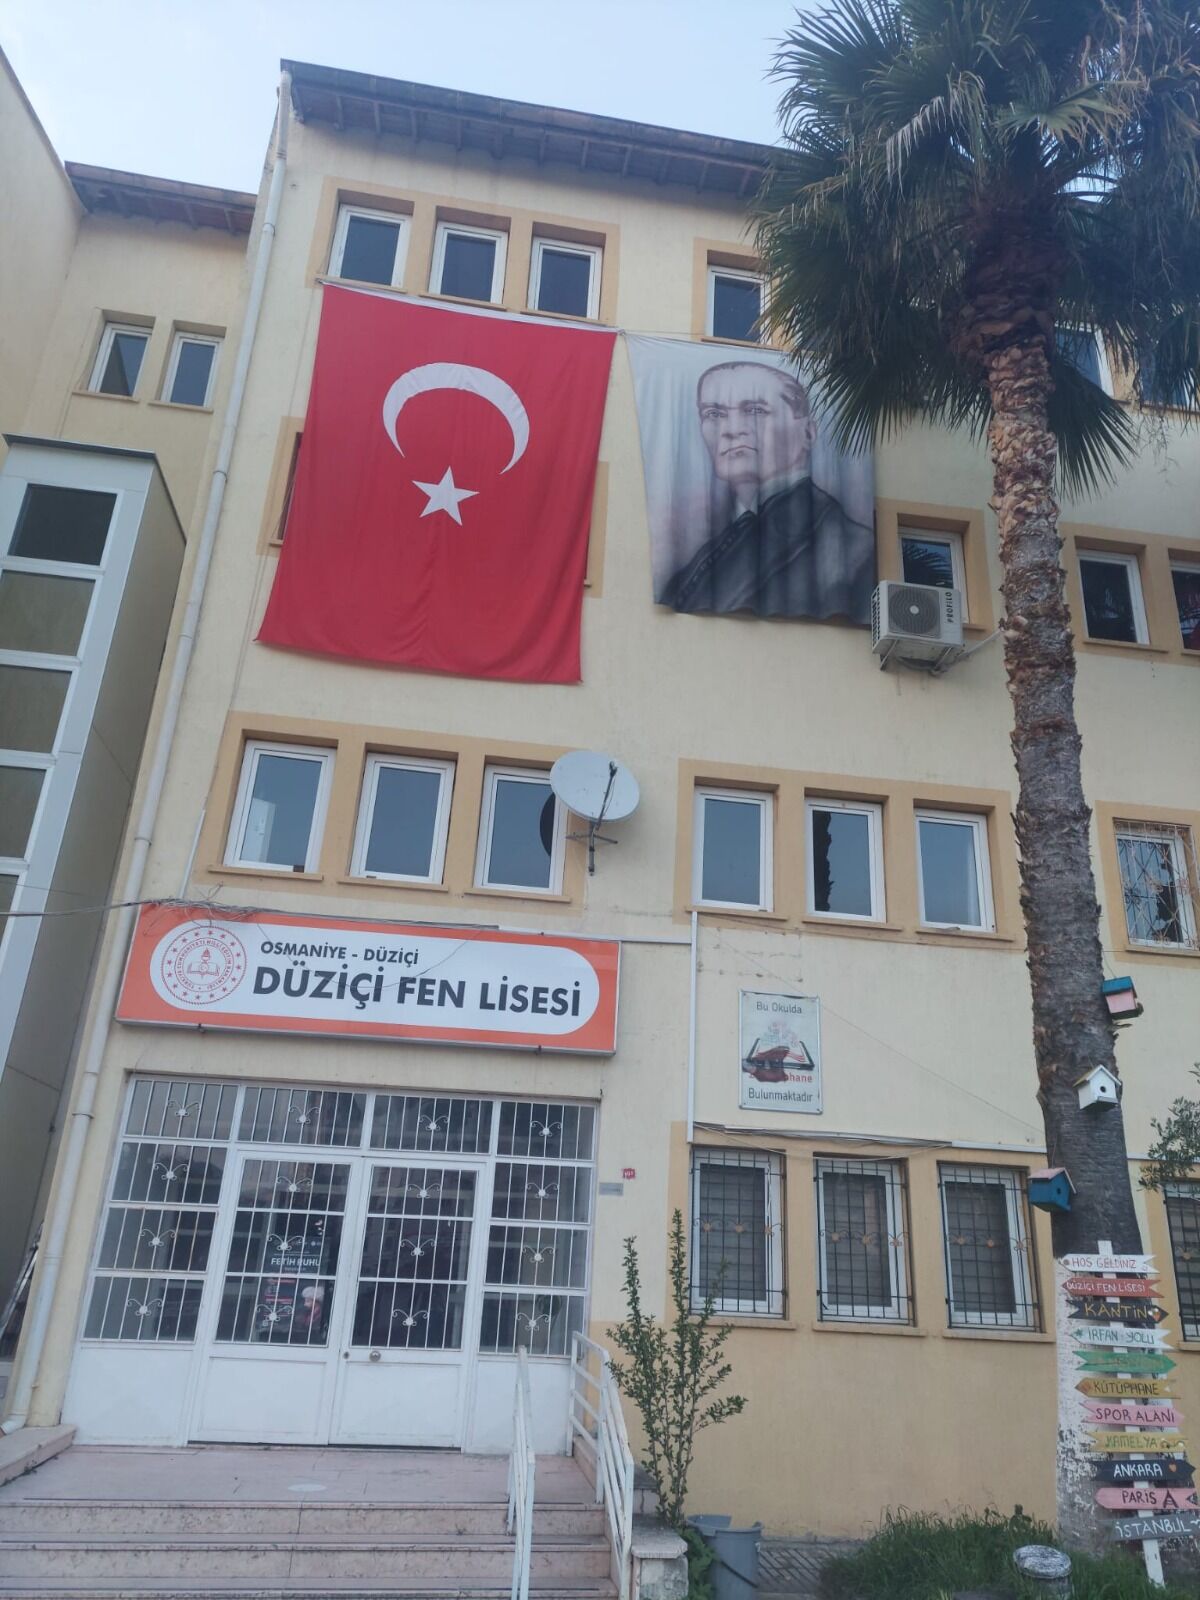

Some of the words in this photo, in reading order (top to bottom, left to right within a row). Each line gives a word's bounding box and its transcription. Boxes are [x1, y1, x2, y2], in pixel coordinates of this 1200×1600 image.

[260, 941, 347, 959] OSMANİYE
[363, 946, 419, 968] DÜZİÇİ
[253, 959, 385, 1010] DÜZİÇİ
[397, 976, 466, 1009] FEN
[479, 975, 581, 1017] LİSESİ
[756, 1001, 768, 1011] Bu
[771, 1002, 802, 1014] Okulda
[748, 1087, 813, 1103] Bulunmaktadır
[1096, 1282, 1117, 1293] FEN
[1084, 1303, 1147, 1319] KANTİN
[1125, 1330, 1155, 1345] YOLU
[1095, 1407, 1131, 1421] SPOR
[1136, 1409, 1175, 1423] ALANI
[1105, 1435, 1158, 1449] KAMELYA
[1113, 1463, 1163, 1478] ANKARA
[1115, 1518, 1192, 1538] İSTANBUL
